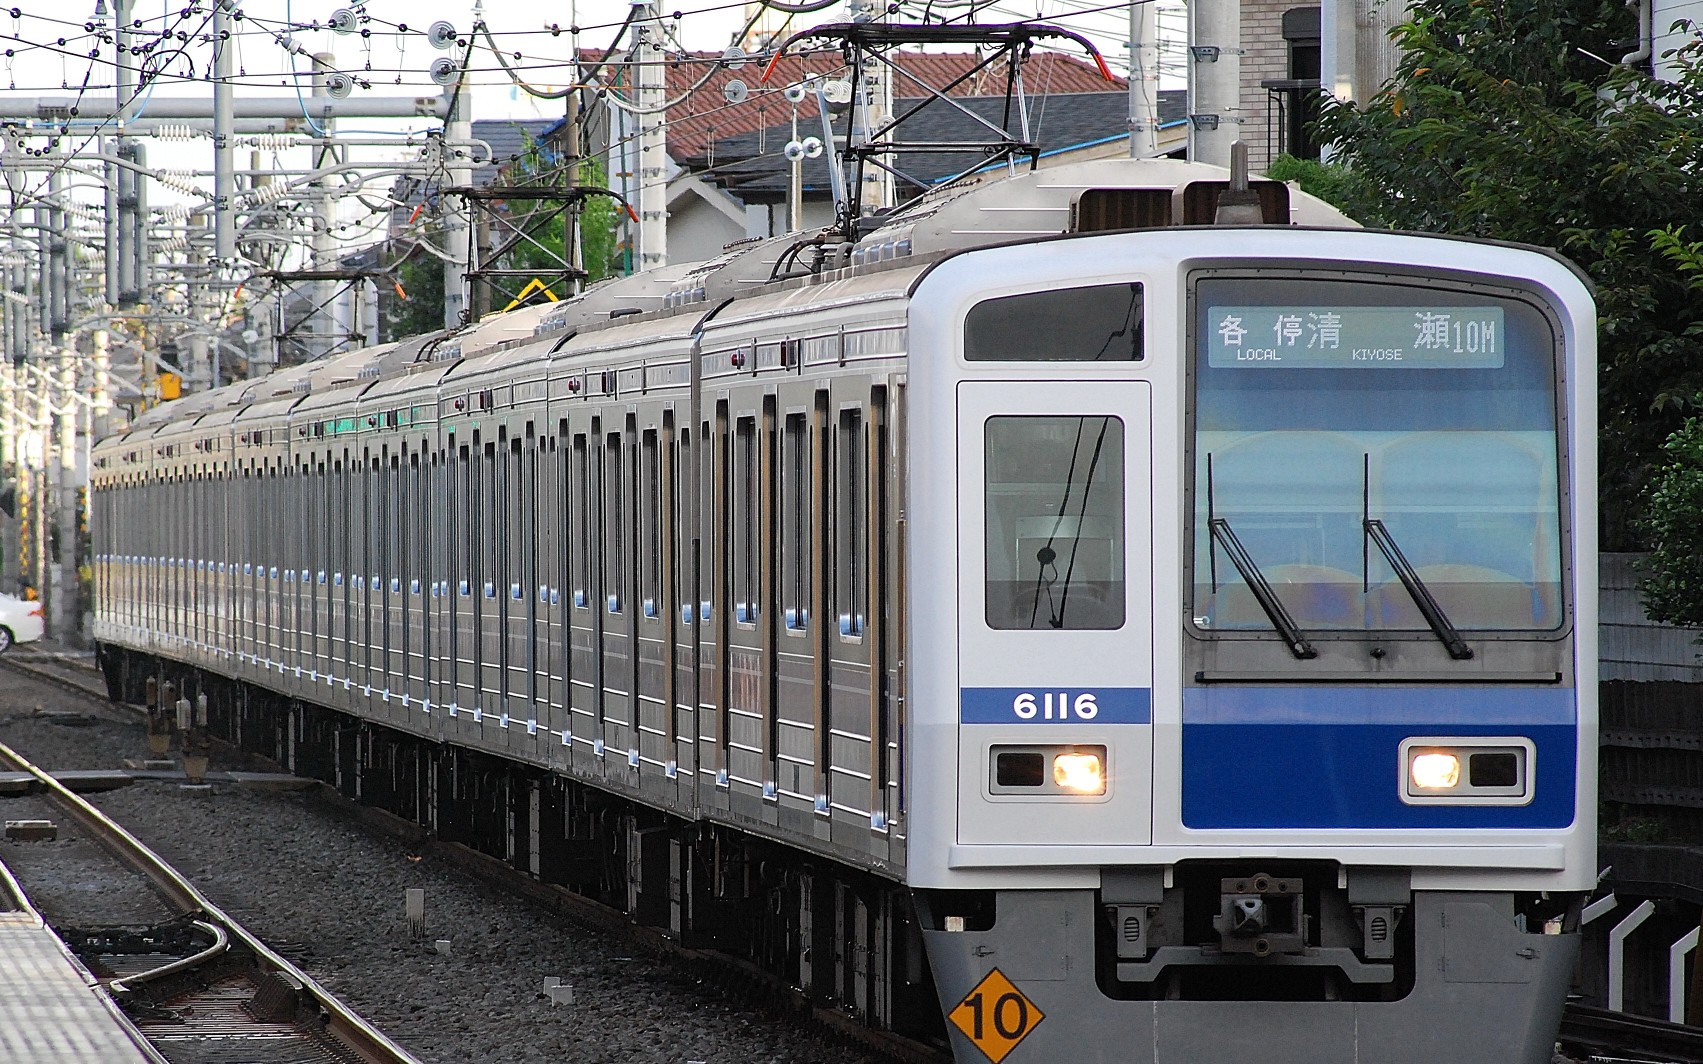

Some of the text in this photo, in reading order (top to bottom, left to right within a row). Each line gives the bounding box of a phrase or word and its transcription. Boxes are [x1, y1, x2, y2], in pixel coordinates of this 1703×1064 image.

[1453, 320, 1495, 353] 10M
[1237, 348, 1403, 361] LOCAL KIYOSE
[1013, 692, 1099, 720] 6116
[964, 992, 1028, 1040] 10
